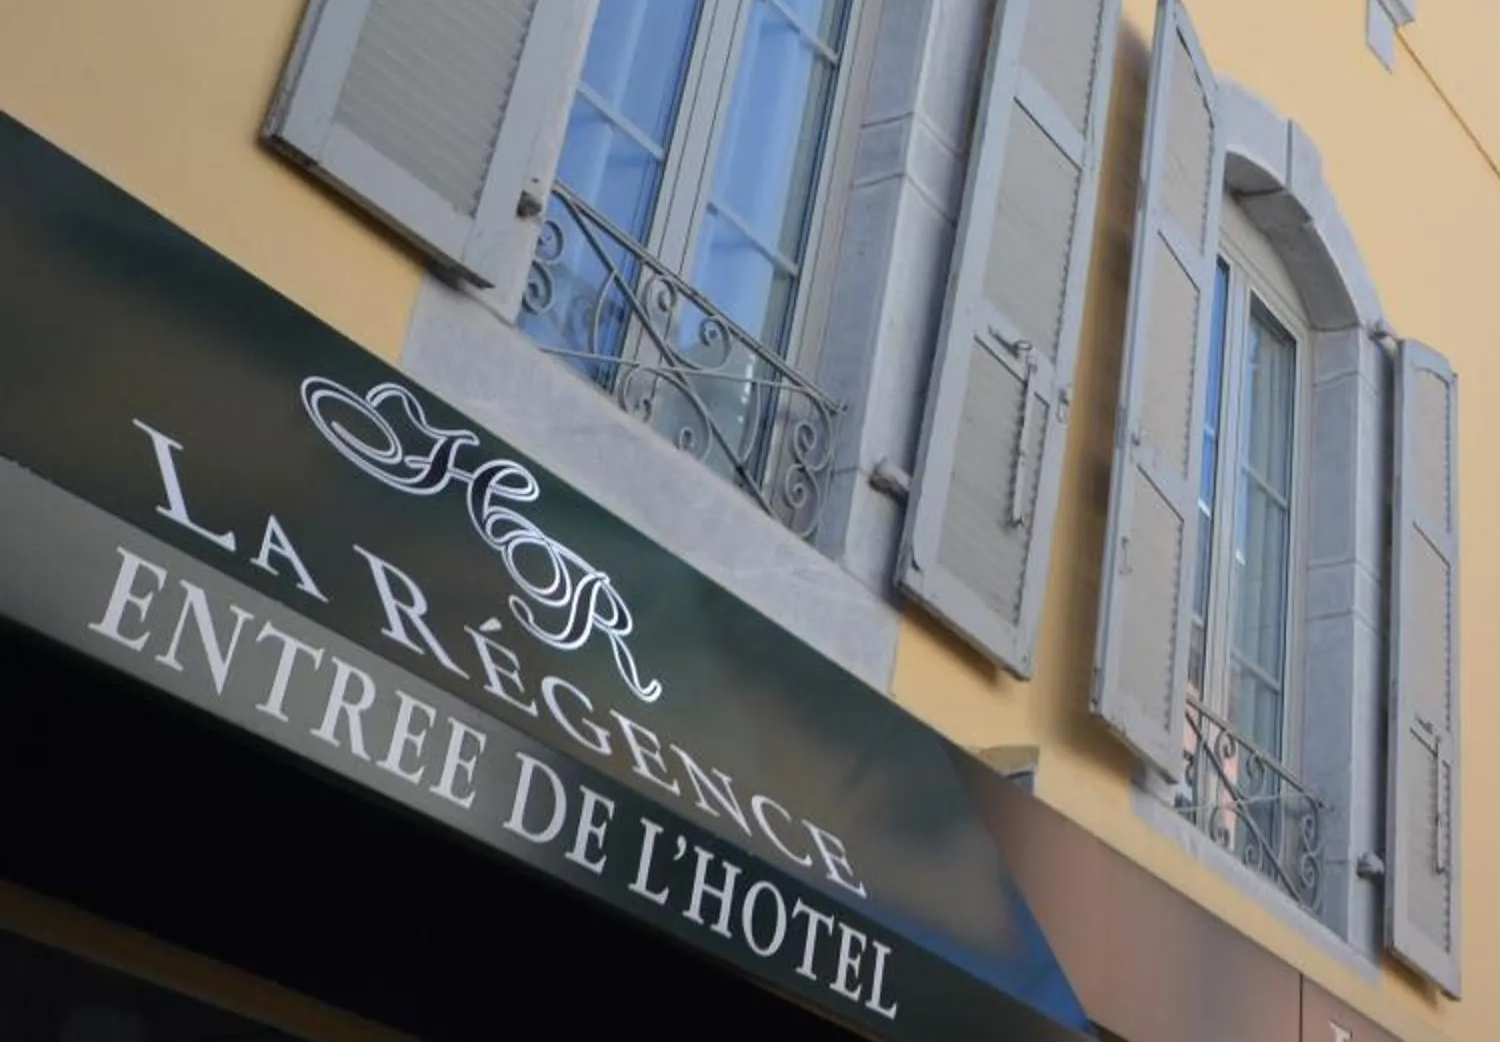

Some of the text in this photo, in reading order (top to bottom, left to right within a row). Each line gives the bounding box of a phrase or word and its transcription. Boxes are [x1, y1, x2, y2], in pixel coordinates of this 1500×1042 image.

[88, 549, 487, 810] ENTREE
[503, 752, 616, 874] DE
[131, 419, 867, 898] LA RÉGENCE
